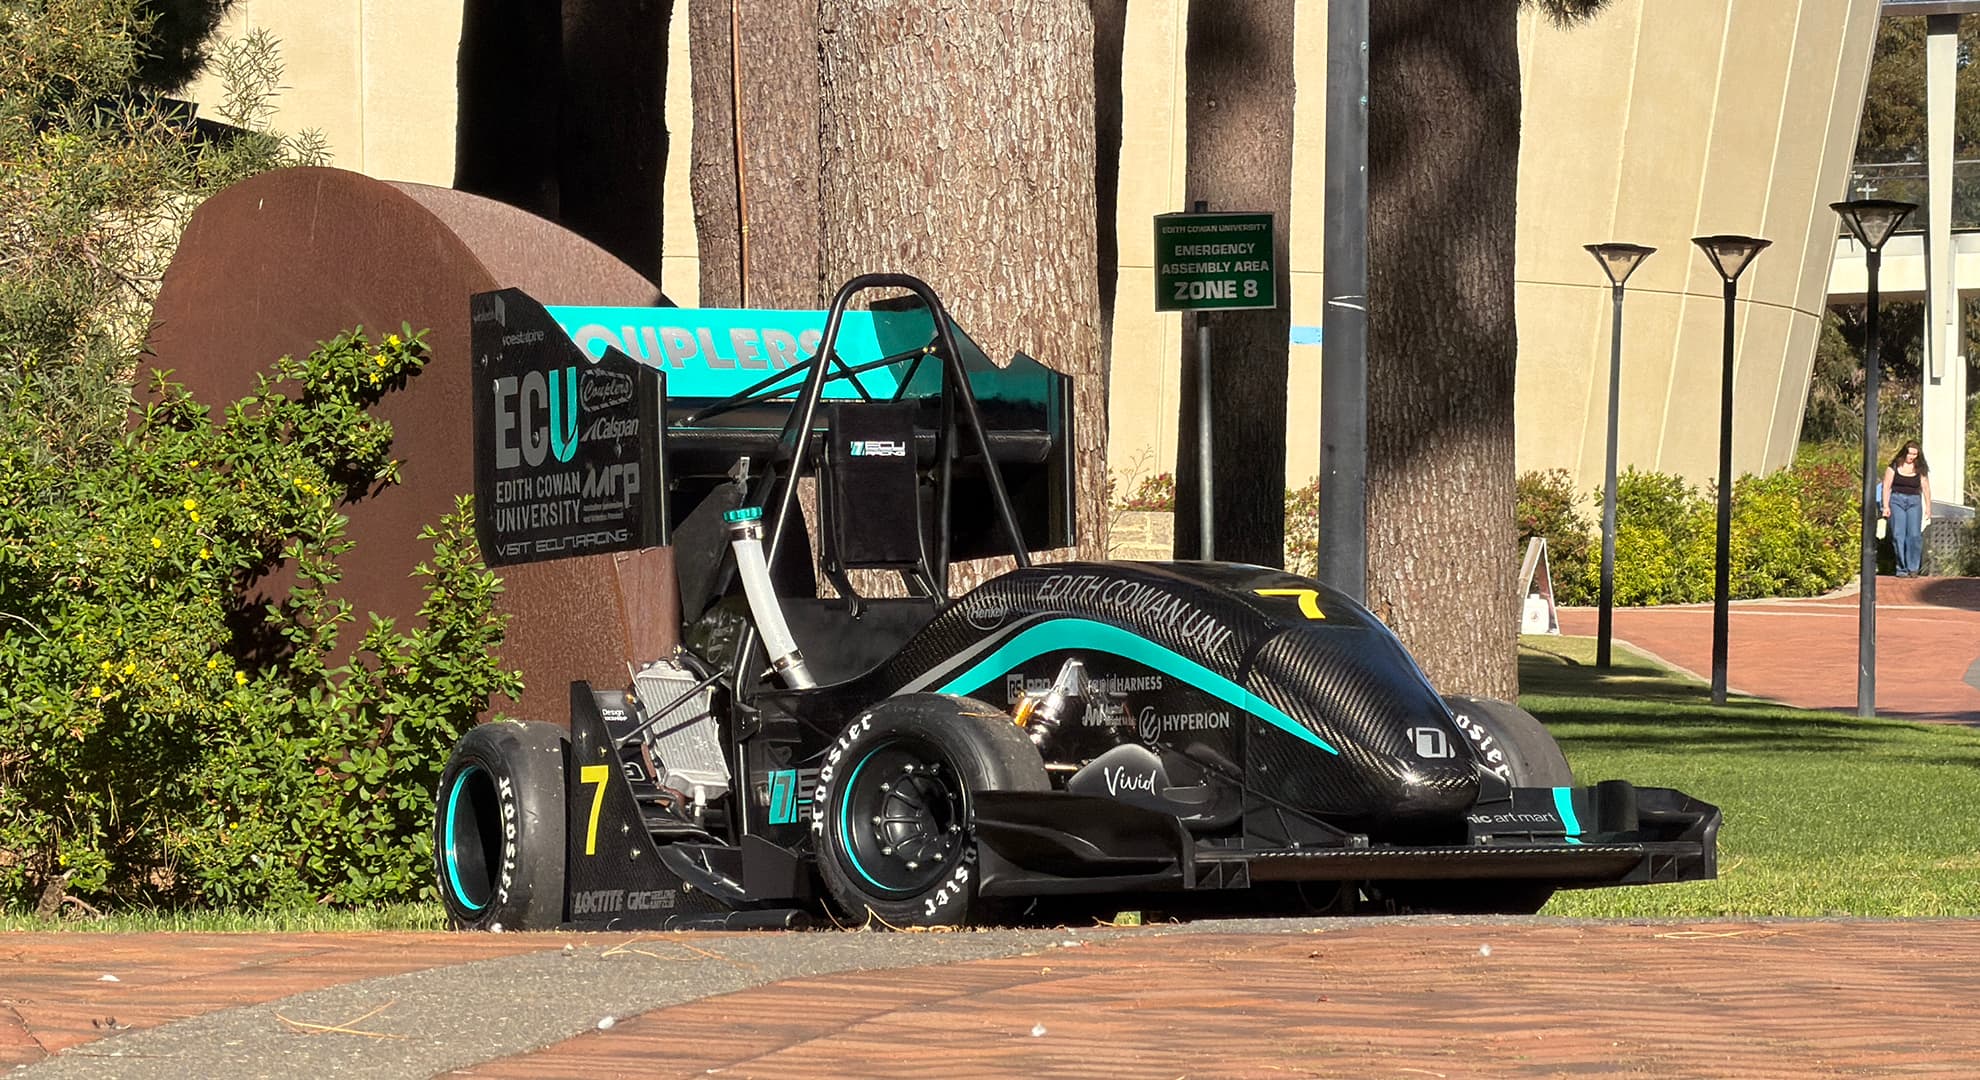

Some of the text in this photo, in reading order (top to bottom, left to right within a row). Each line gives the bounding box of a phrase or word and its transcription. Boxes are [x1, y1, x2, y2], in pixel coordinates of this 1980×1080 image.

[1162, 223, 1267, 234] EDITH COWAN UNIVERSITY
[1175, 243, 1255, 256] EMERGENCY
[1162, 261, 1269, 275] ASSEMBLY AREA
[1174, 280, 1258, 300] ZONE 8
[494, 366, 578, 470] ECU
[596, 417, 640, 443] Calspan
[496, 472, 581, 503] EDITH COWAN
[496, 498, 581, 533] UNIVERSITY
[495, 541, 534, 558] VISIT
[971, 605, 1004, 620] Henkel
[1037, 574, 1106, 602] EDITH
[1102, 578, 1188, 628] COWAN
[1254, 588, 1326, 620] 7
[1163, 712, 1230, 732] HYPERION
[1456, 714, 1511, 778] osier
[811, 713, 873, 837] Hoosier
[1104, 765, 1156, 796] Vivid
[580, 765, 609, 856] 7
[1467, 813, 1492, 824] nic
[574, 889, 624, 914] LOCTITE
